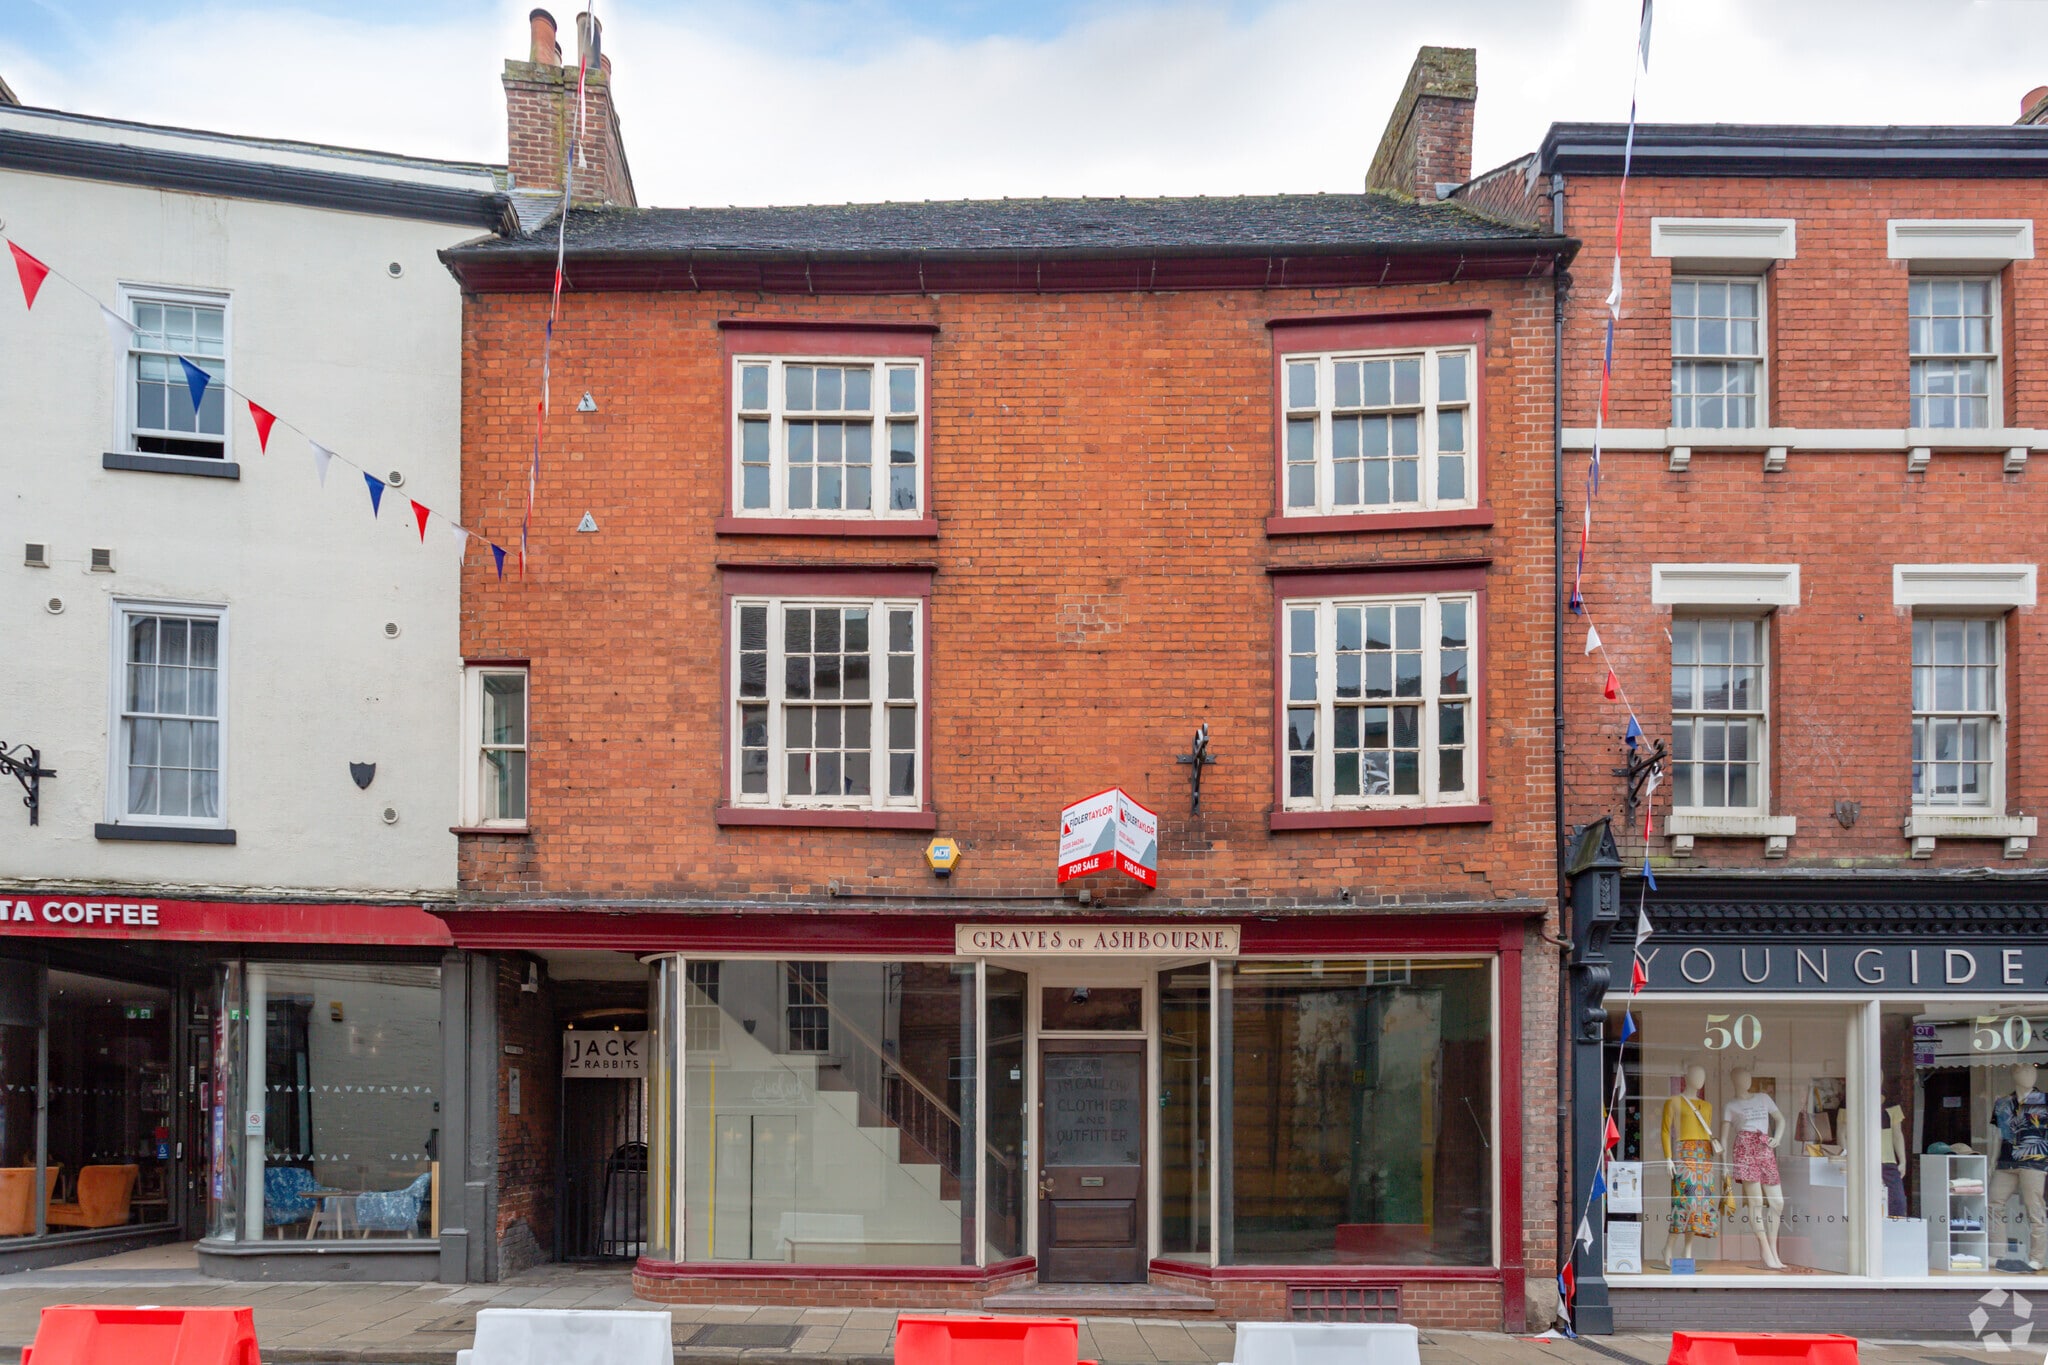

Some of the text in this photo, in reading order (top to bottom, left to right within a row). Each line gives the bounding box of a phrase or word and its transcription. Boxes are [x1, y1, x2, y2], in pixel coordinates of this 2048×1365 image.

[1069, 805, 1113, 827] FIDLERTAYLOR
[933, 848, 950, 857] ADT
[1069, 857, 1099, 876] FOR SALE
[1124, 860, 1146, 880] FOR SALE
[42, 901, 160, 926] COFFEE
[973, 930, 1229, 950] GRAVES OF ASHBOURNE.
[1703, 1013, 1762, 1050] 50
[1973, 1015, 2032, 1051] 50
[570, 1039, 638, 1062] JACK
[584, 1060, 640, 1069] RABBITS
[1057, 1099, 1128, 1112] CLOTHIER
[1077, 1117, 1106, 1125] AND
[1056, 1130, 1129, 1145] OUTFITTER
[1728, 1214, 1850, 1223] COLLECTION
